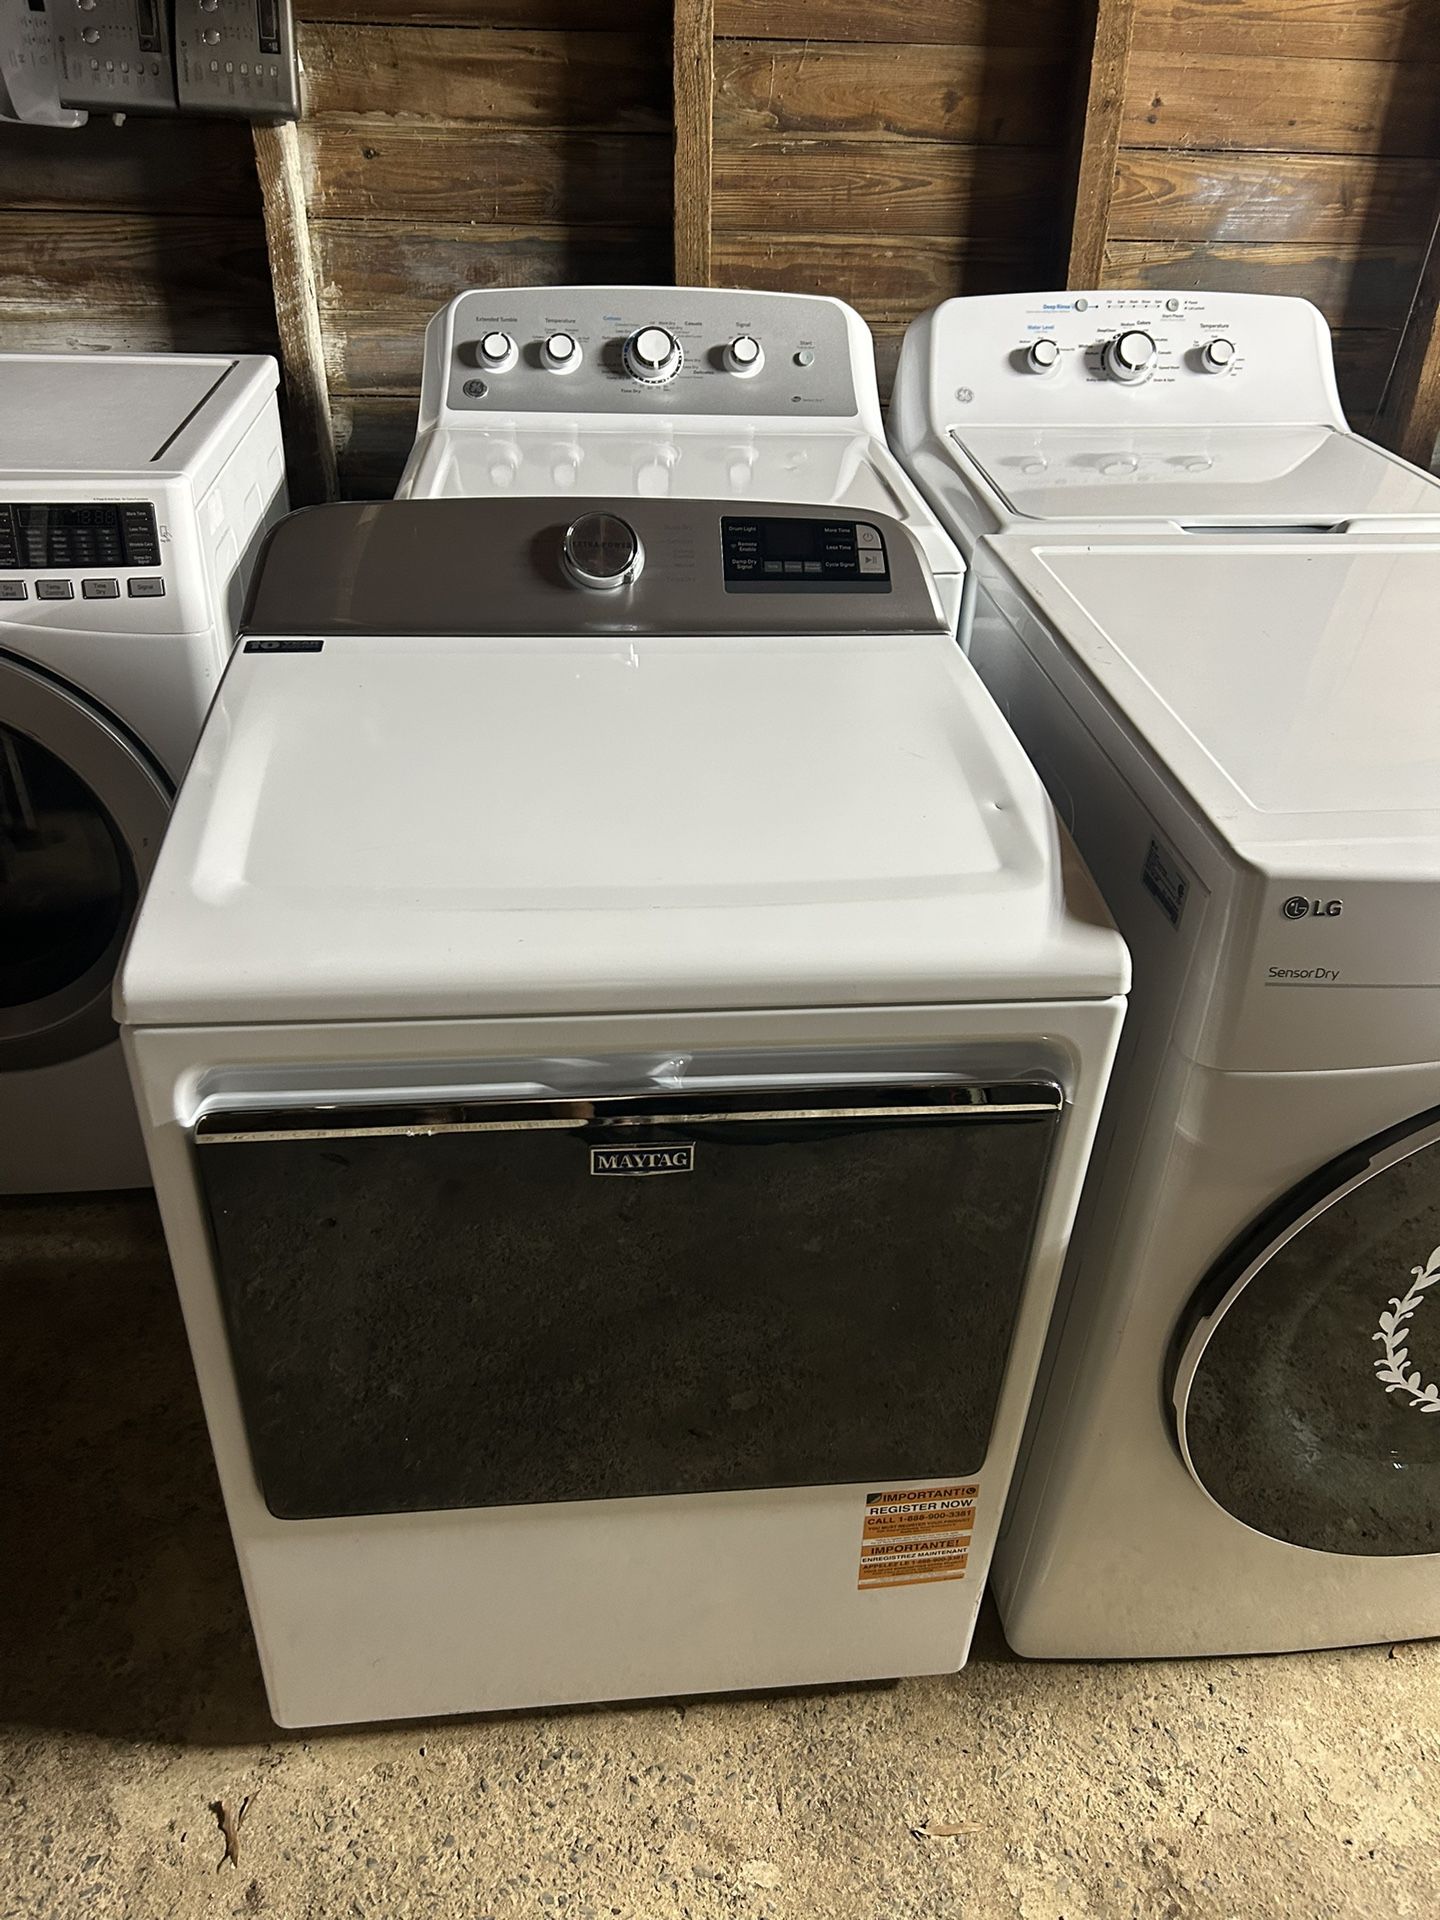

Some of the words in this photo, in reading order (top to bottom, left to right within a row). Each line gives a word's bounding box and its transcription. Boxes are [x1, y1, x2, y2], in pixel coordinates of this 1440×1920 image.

[1312, 899, 1343, 917] LG
[1268, 966, 1341, 981] SensorDry
[598, 1152, 688, 1169] MAYTAG
[882, 1487, 966, 1503] IMPORTANT!
[870, 1502, 937, 1516] REGISTER
[940, 1499, 974, 1509] NOW
[867, 1517, 896, 1526] CALL
[862, 1553, 917, 1563] ENREGISTREZ
[917, 1547, 968, 1558] MAINTENANT
[871, 1540, 960, 1555] IMPORTANTE!
